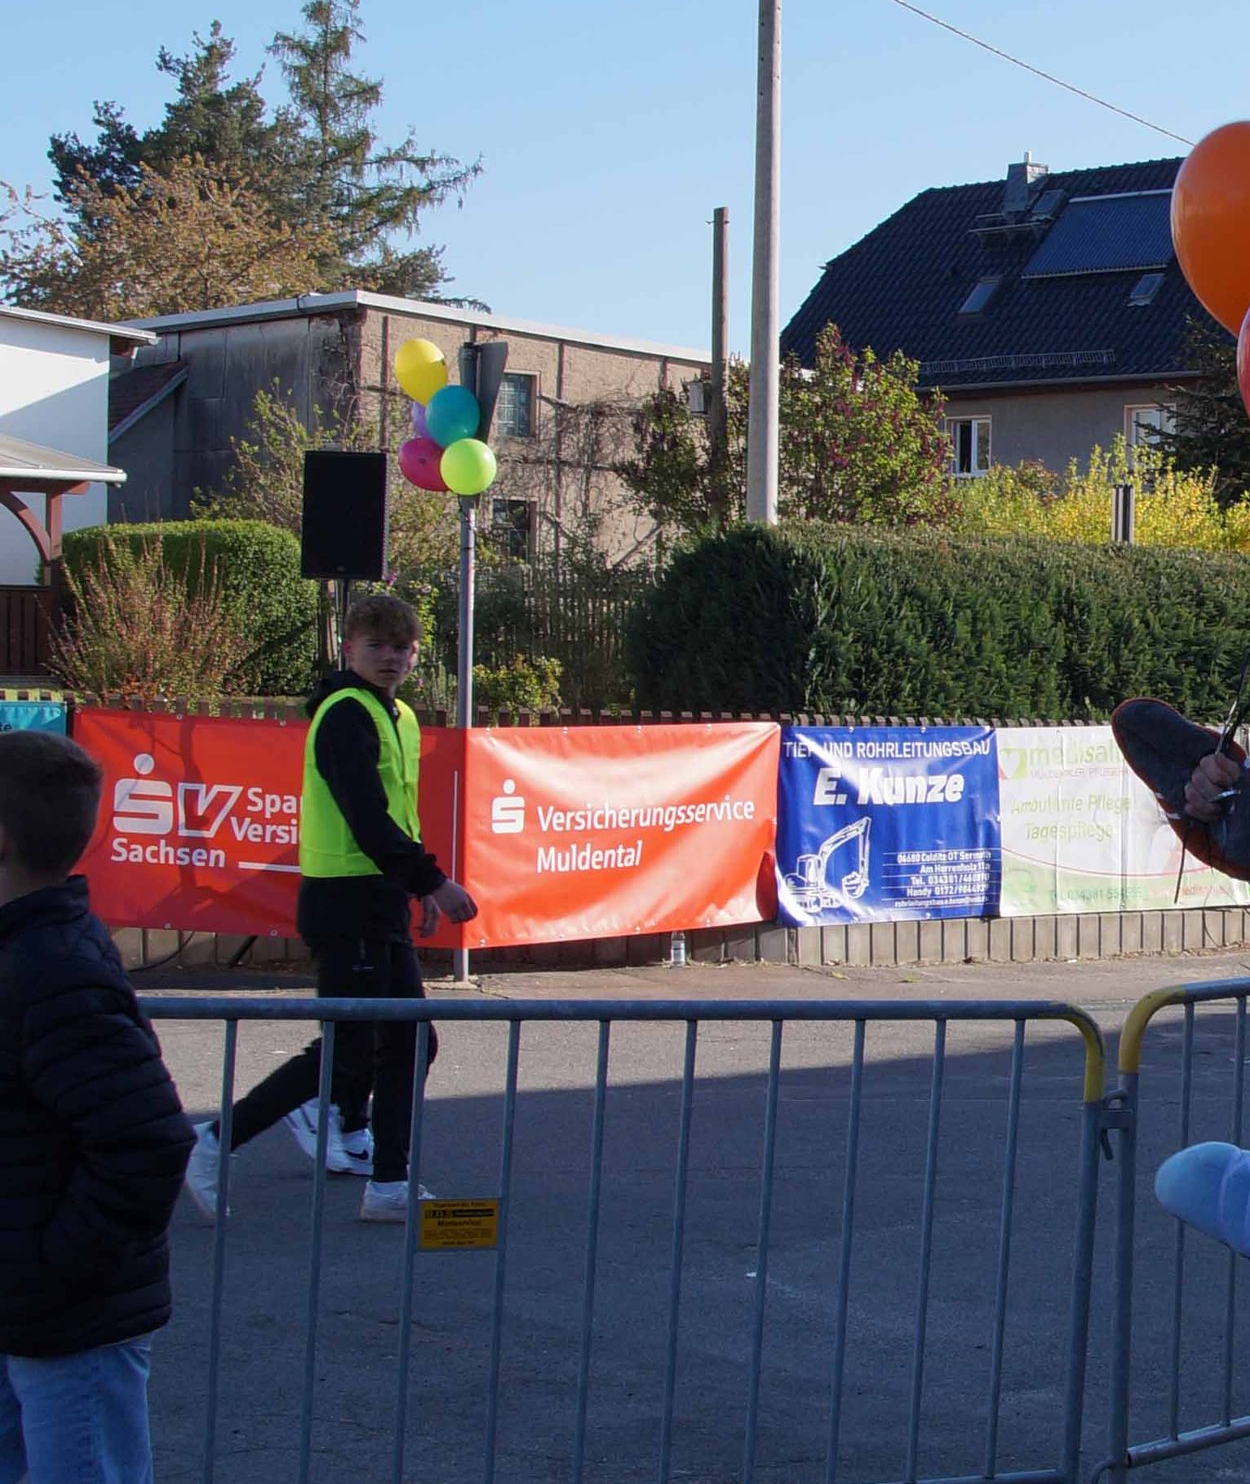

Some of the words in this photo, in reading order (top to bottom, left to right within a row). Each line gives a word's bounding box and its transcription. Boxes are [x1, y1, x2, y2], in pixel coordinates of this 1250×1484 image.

[823, 741, 853, 758] UND
[857, 739, 991, 759] ROHRLEITUNGSBAU
[247, 787, 303, 818] Spa
[813, 767, 848, 806] E.
[857, 767, 965, 806] Kunze
[537, 796, 755, 832] Versicherungsservice
[111, 837, 225, 868] Sachsen
[536, 840, 643, 873] Muldental
